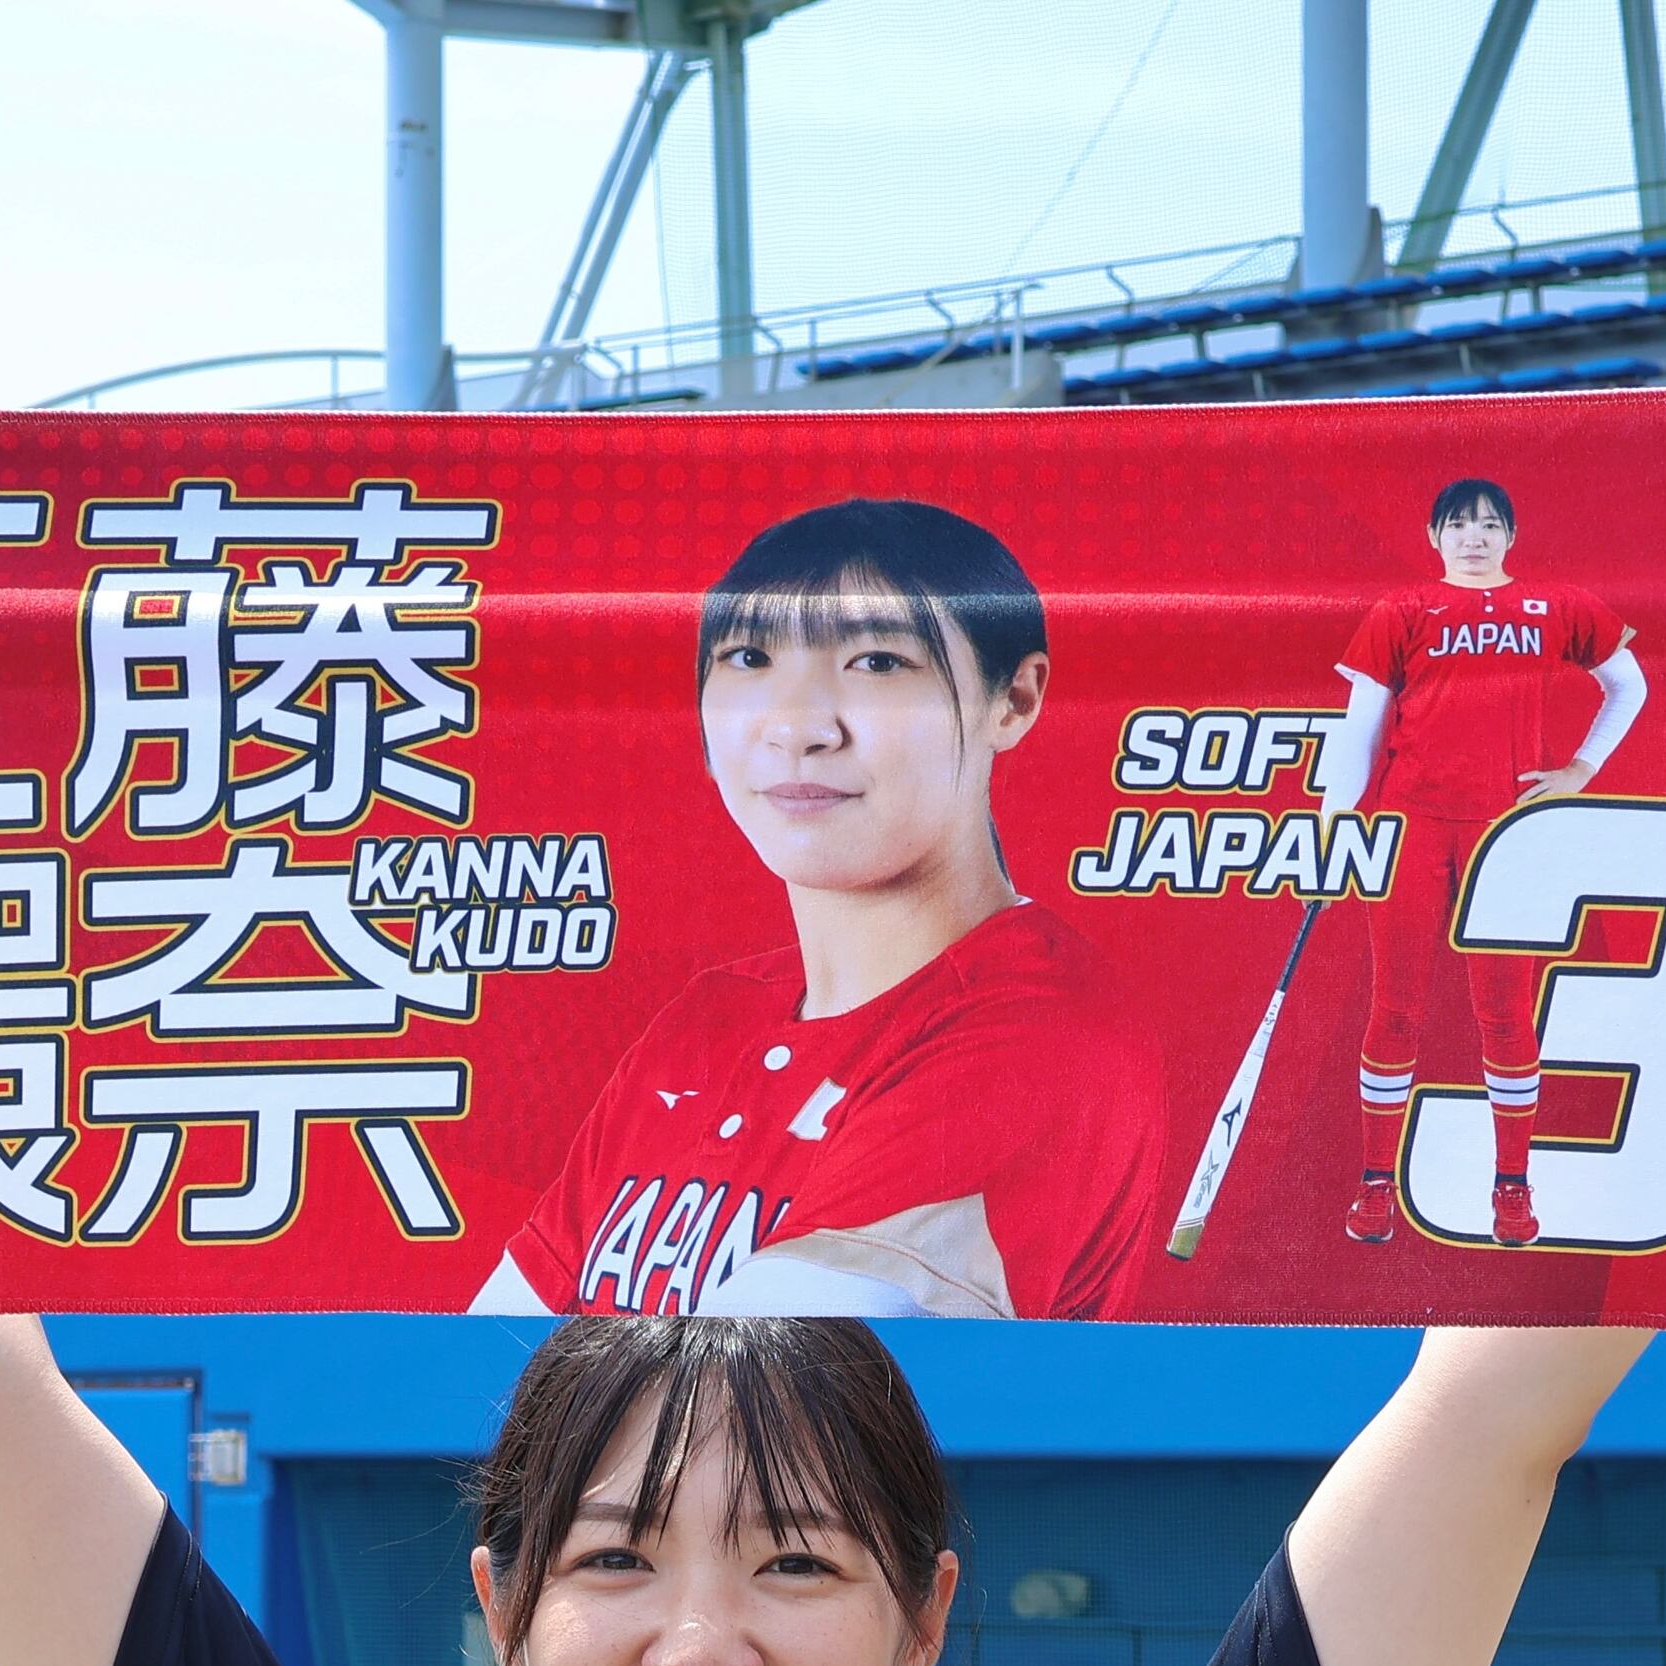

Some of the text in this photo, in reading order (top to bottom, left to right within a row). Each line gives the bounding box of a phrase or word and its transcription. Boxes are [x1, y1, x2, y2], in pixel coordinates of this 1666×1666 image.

[1427, 622, 1543, 657] JAPAN
[350, 834, 610, 907] KANNA
[1071, 812, 1400, 895] JAPAN
[410, 902, 615, 974] KUDO
